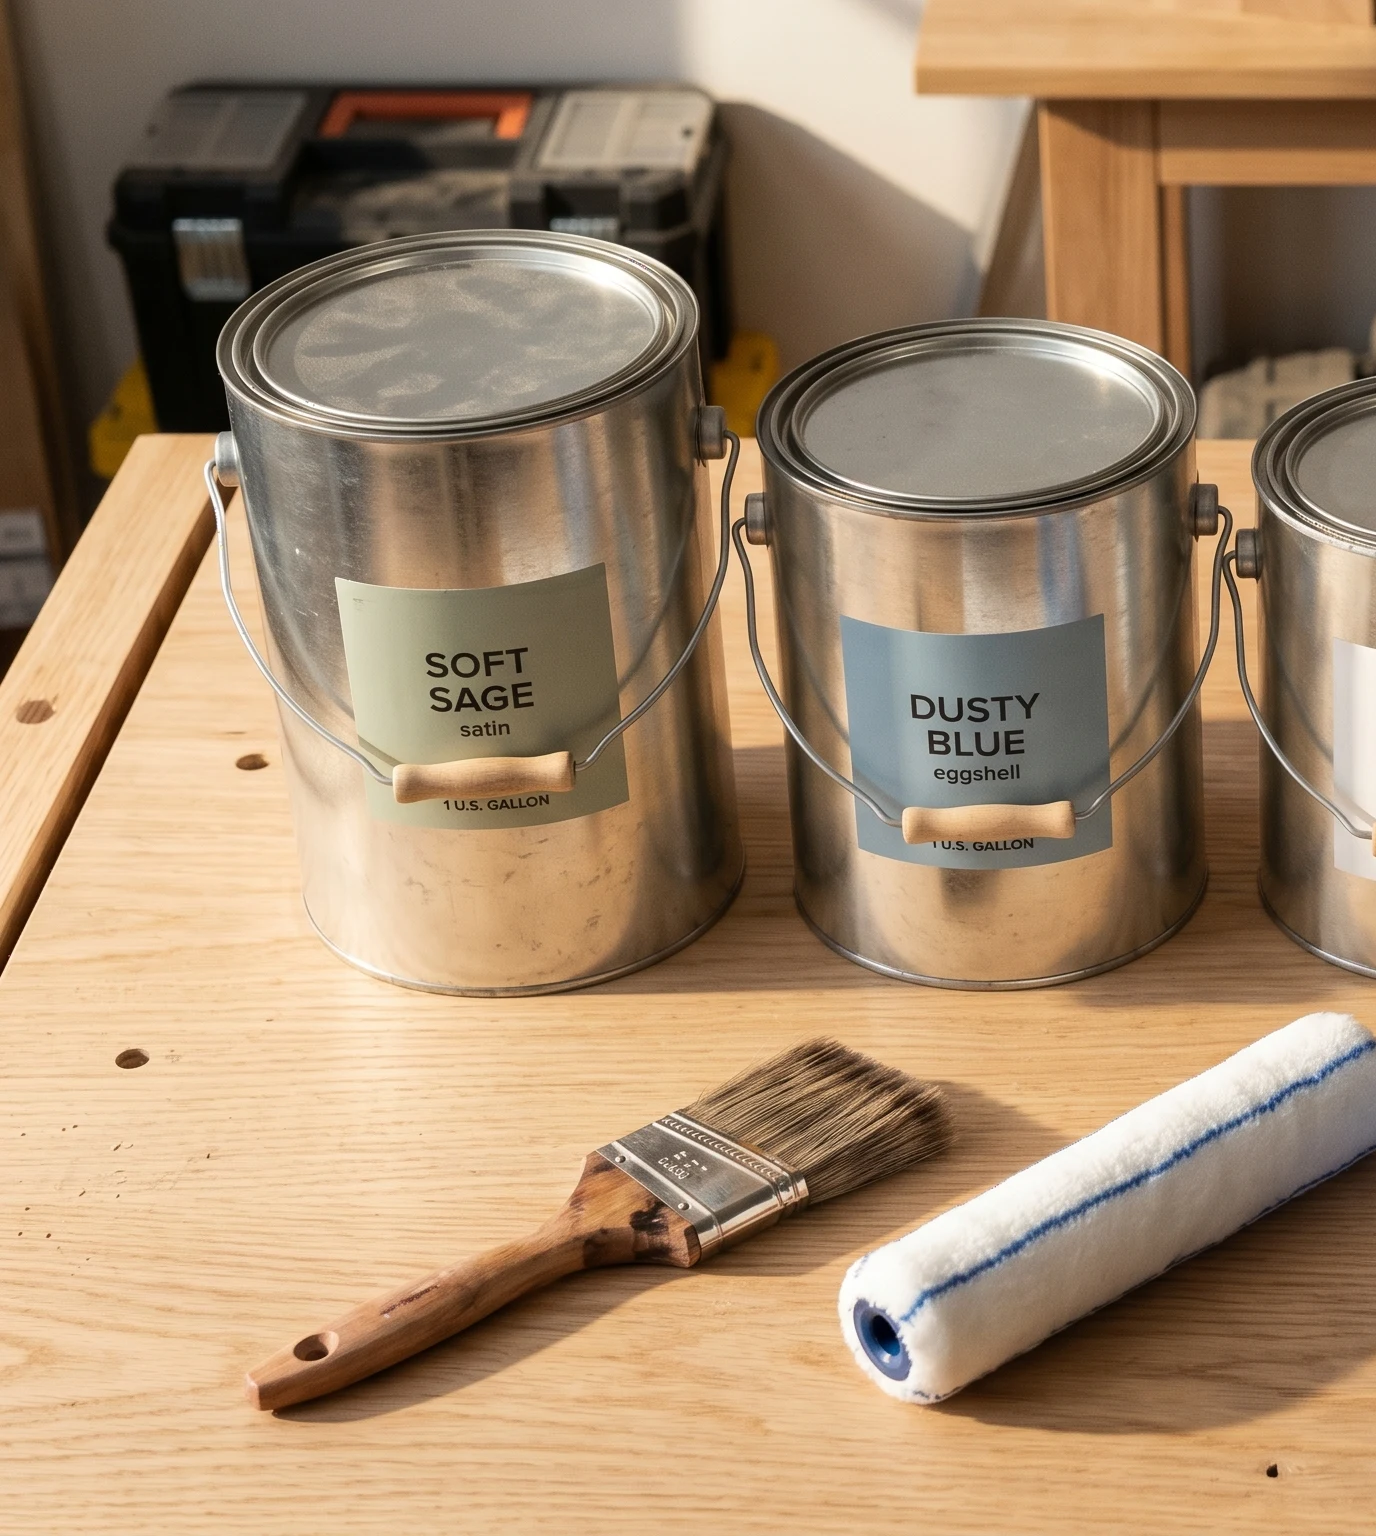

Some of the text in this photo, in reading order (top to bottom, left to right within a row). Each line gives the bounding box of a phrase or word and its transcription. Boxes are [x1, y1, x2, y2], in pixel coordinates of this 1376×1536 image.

[425, 647, 528, 678] SOFT
[429, 681, 534, 712] SAGE
[910, 693, 1040, 722] DUSTY
[460, 720, 510, 737] satin
[927, 730, 1025, 756] BLUE
[933, 764, 1020, 785] eggshell
[443, 794, 550, 811] 1 U.S. GALLON
[941, 840, 969, 851] U.S.
[972, 838, 1034, 851] GALLON
